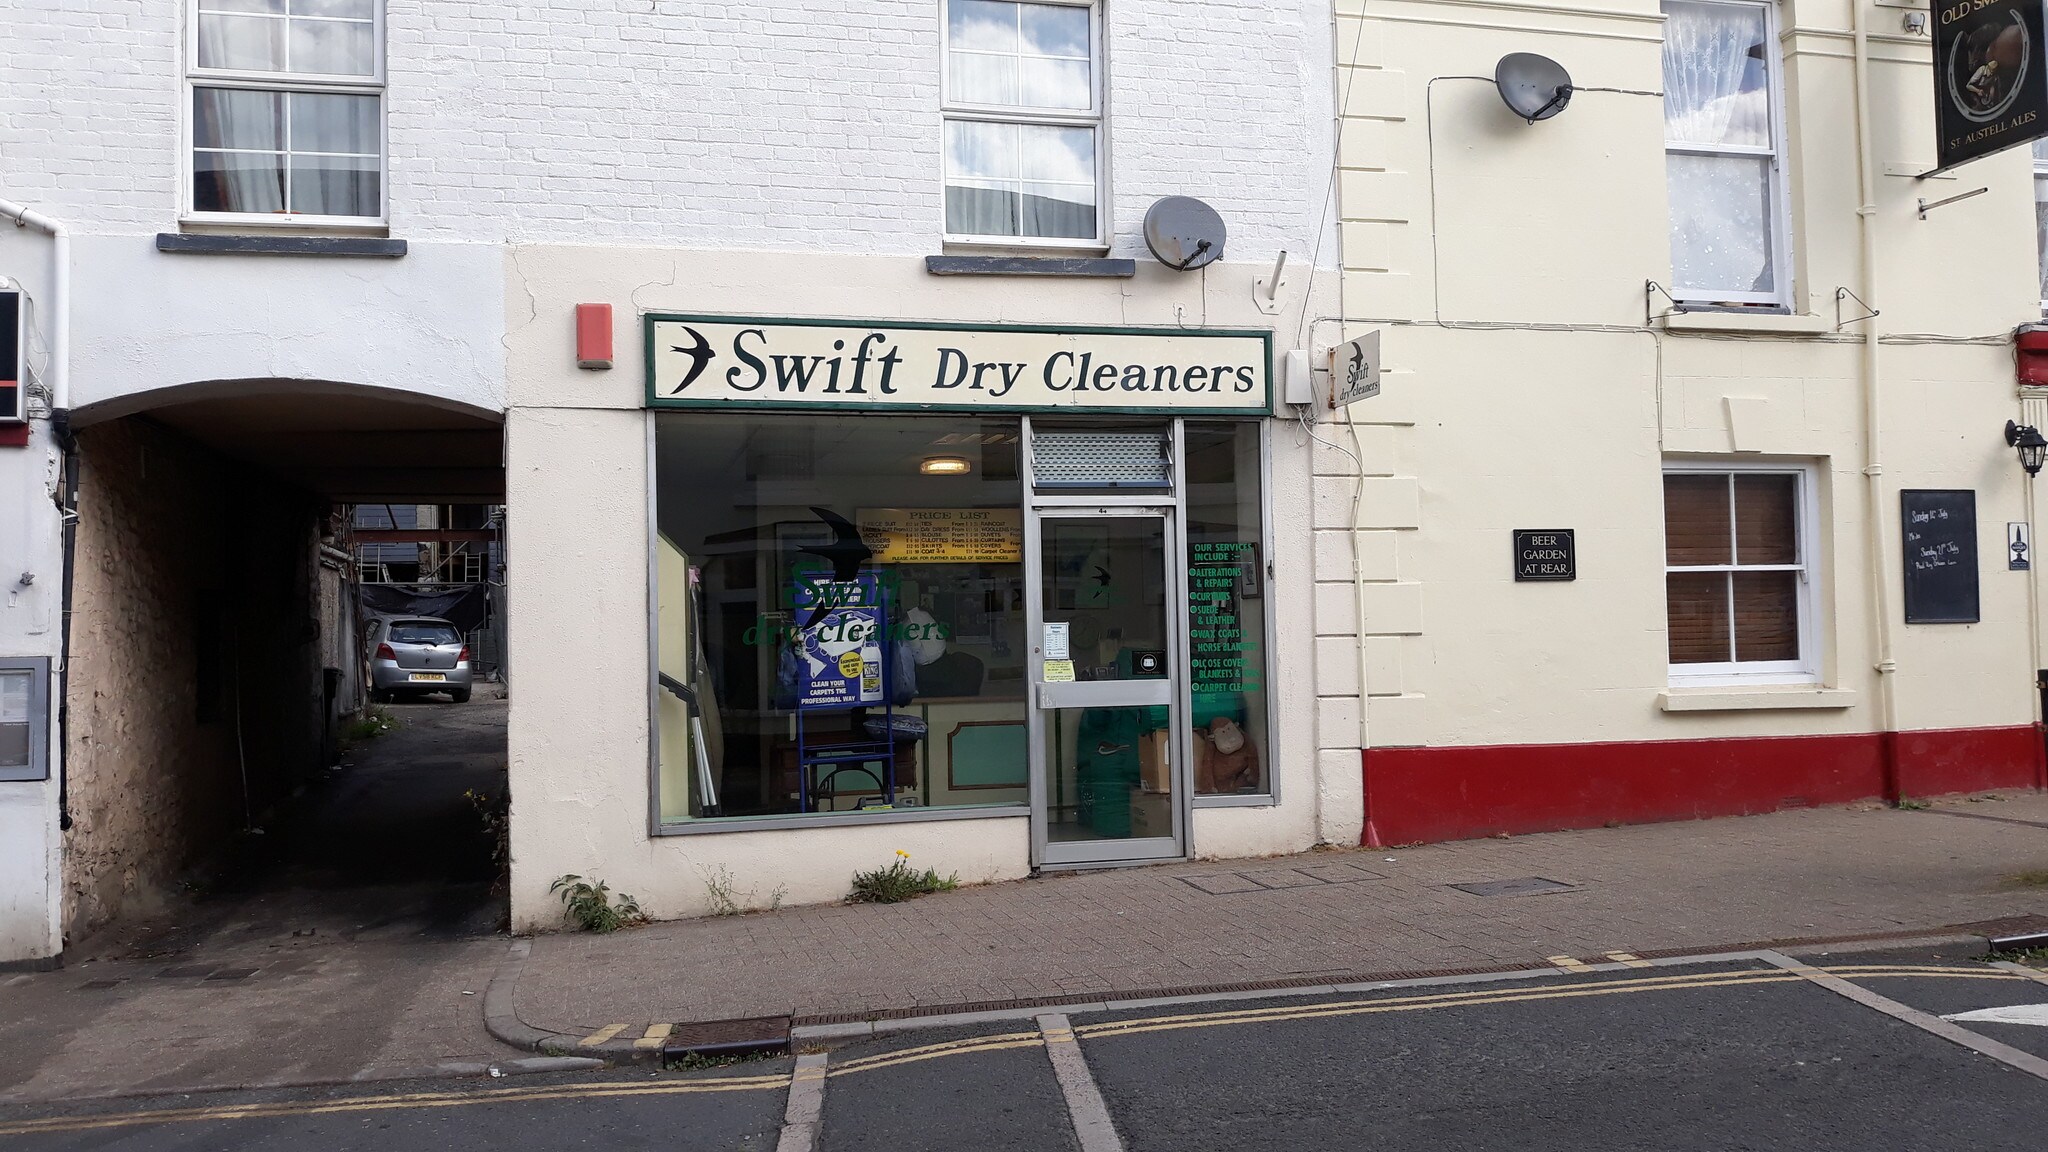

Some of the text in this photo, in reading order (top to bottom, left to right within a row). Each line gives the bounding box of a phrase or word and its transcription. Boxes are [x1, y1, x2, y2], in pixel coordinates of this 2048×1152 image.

[1942, 1, 1970, 25] OLD
[1965, 121, 2008, 145] AUSTELL
[2011, 110, 2037, 128] ALES
[727, 328, 1255, 397] Swift Dry Cleaners
[1347, 362, 1369, 384] Swift
[1340, 381, 1378, 403] dry cleaners
[910, 511, 991, 520] PRICE LIST
[1531, 535, 1558, 546] BEER
[1194, 543, 1253, 552] OUR SERVICES
[1194, 553, 1229, 561] INCLUDE
[1523, 549, 1567, 560] GARDEN
[1196, 567, 1242, 577] ALTERATIONS
[1524, 563, 1567, 574] AT REAR
[784, 561, 902, 610] Swift
[1196, 578, 1233, 588] & REPAIRS
[1197, 605, 1219, 614] SUEDE
[1197, 615, 1236, 625] & LEATHER
[742, 613, 951, 647] dry cleaners
[1198, 629, 1216, 638] WAX
[1218, 629, 1240, 638] COATS
[1197, 642, 1221, 652] HORSE
[1199, 669, 1233, 679] BLANKETS
[1235, 669, 1241, 677] &
[811, 680, 829, 688] CLEAN
[1199, 683, 1227, 692] CARPET
[801, 697, 842, 705] PROFESSIONAL
